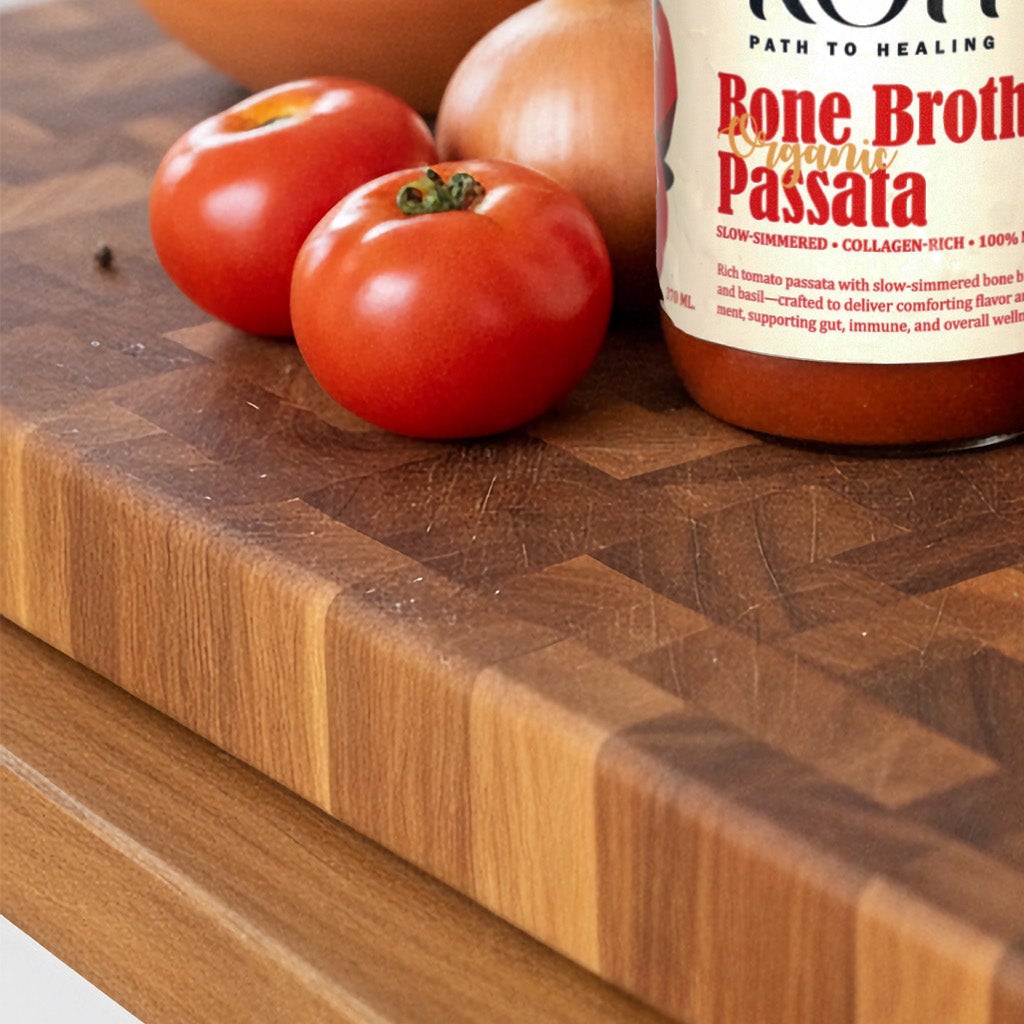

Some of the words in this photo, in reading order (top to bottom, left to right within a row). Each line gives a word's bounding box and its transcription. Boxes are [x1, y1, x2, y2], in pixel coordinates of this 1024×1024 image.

[749, 35, 808, 54] PATH
[827, 42, 857, 56] TO
[877, 36, 995, 57] HEALING
[718, 71, 851, 146] Bone
[718, 113, 898, 189] Organic
[718, 150, 927, 228] Passata
[716, 225, 828, 250] SLOW-SIMMERED
[842, 237, 965, 252] COLLAGEN-RICH
[979, 232, 1018, 249] 100%
[717, 263, 739, 280] Rich
[741, 269, 783, 286] tomato
[785, 276, 835, 290] passata
[838, 278, 869, 292] with
[873, 274, 979, 292] slow-simmered
[983, 273, 1014, 288] bone
[717, 284, 735, 298] and
[827, 299, 841, 311] to
[844, 298, 893, 312] deliver
[896, 296, 973, 313] comforting
[975, 292, 1012, 308] flavor
[717, 305, 746, 321] ment,
[747, 311, 816, 332] supporting
[819, 320, 845, 334] gut,
[849, 319, 911, 334] immune,
[914, 318, 940, 331] and
[944, 314, 989, 331] overall
